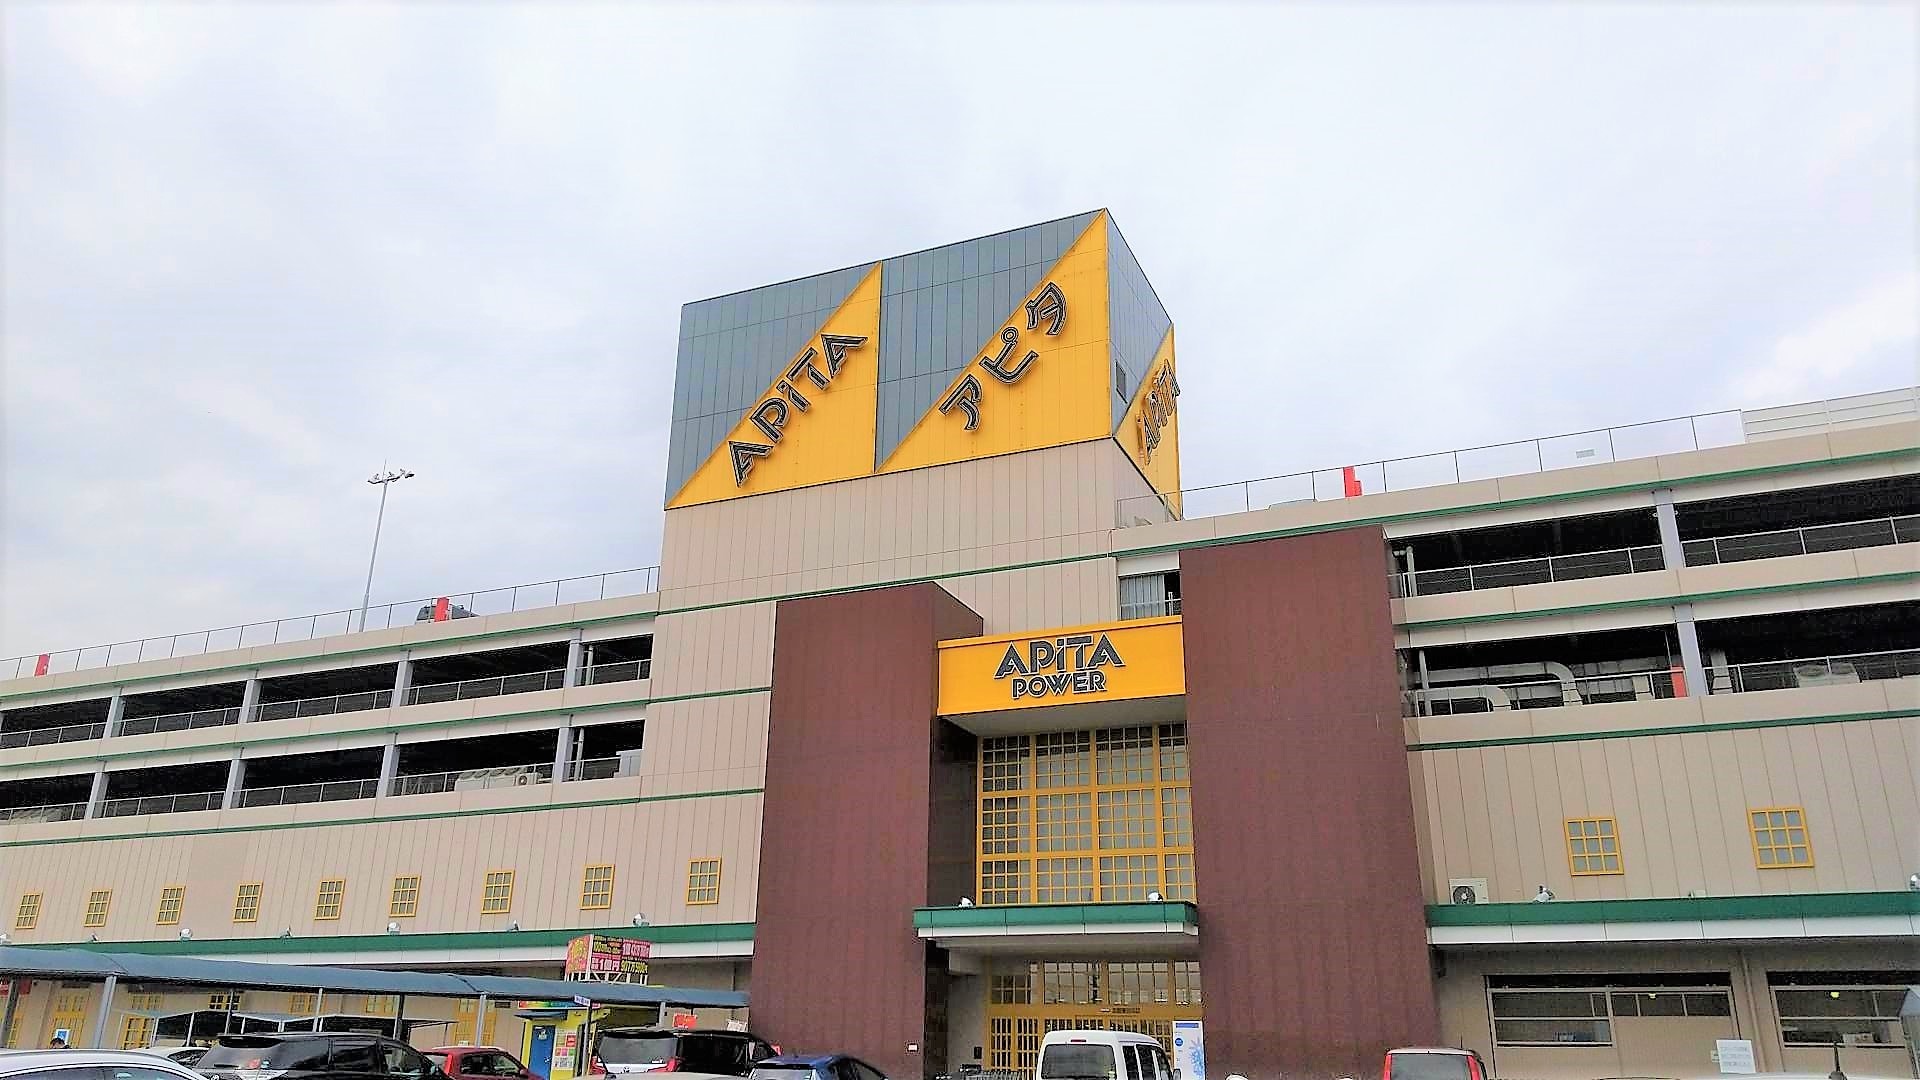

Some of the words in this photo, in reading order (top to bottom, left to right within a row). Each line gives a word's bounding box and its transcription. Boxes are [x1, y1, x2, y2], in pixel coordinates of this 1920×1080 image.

[938, 281, 1068, 431] アピタ
[1012, 670, 1108, 699] POWER
